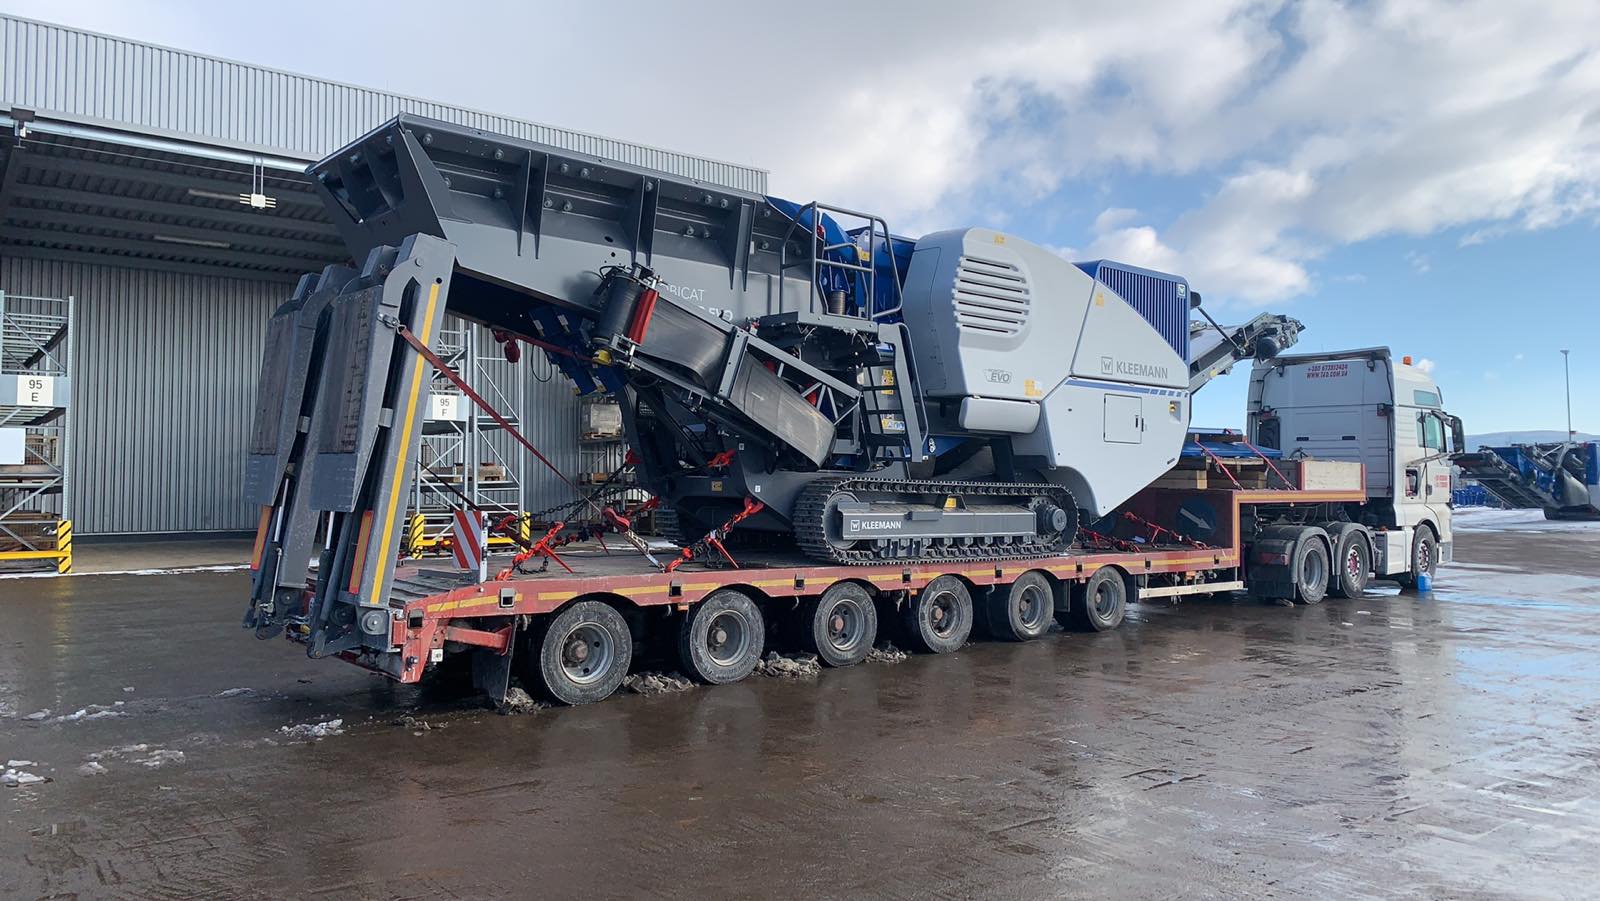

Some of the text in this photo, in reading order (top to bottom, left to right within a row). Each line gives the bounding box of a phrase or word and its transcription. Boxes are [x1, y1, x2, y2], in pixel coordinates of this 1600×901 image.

[660, 283, 705, 301] BICAT
[1116, 361, 1168, 379] KLEEMANN
[991, 372, 1010, 383] EVO
[28, 380, 43, 390] 95
[31, 392, 39, 402] E
[440, 398, 450, 407] 95
[442, 409, 448, 417] F
[861, 520, 902, 530] KLEEMANN
